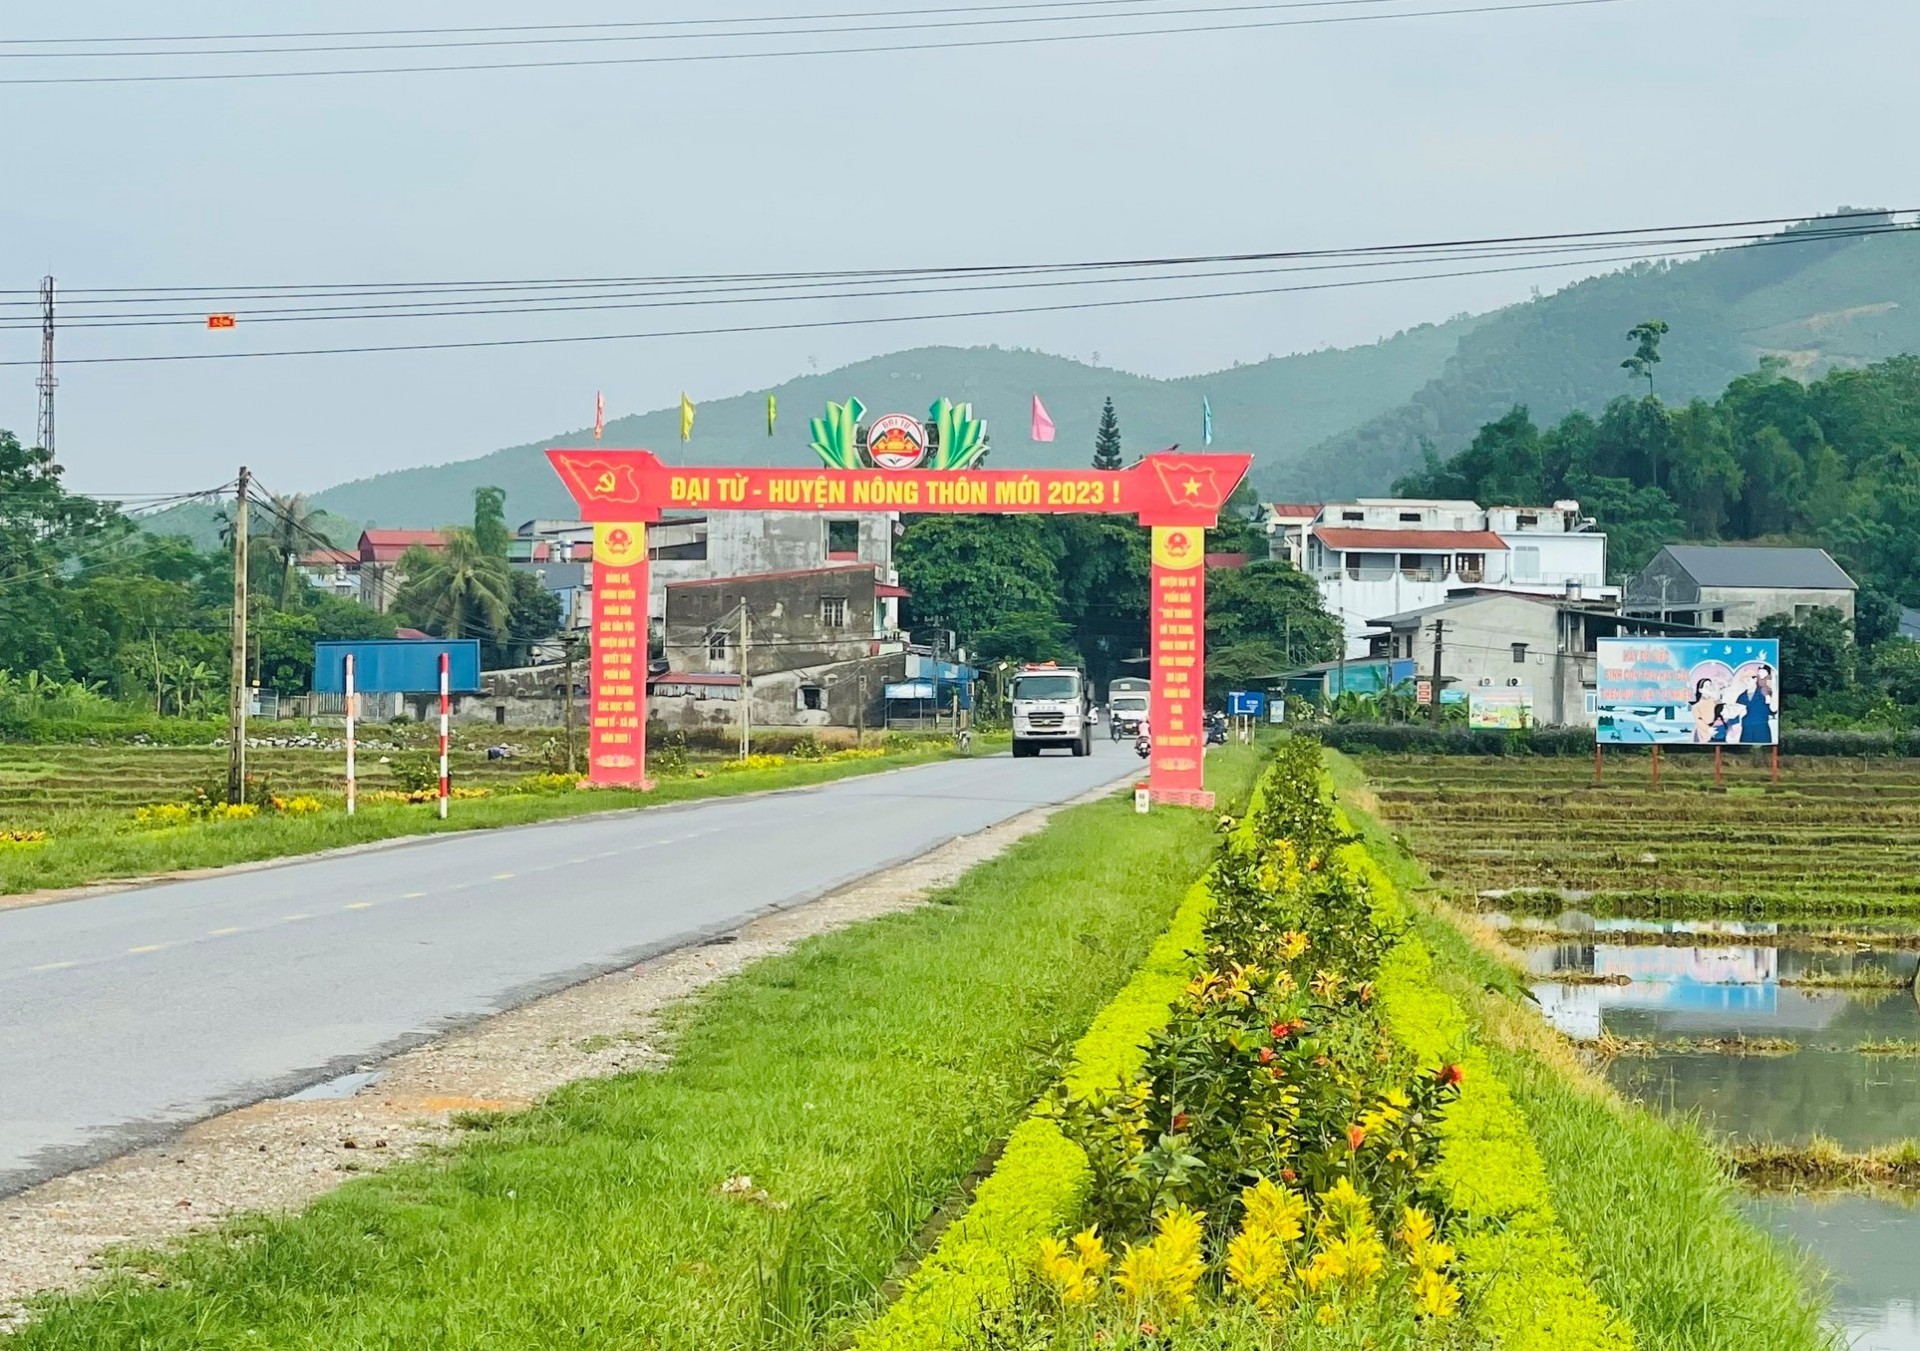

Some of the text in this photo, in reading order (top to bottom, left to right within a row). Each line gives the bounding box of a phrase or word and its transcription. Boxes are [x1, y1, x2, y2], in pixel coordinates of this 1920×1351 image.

[671, 477, 710, 506] ĐẠI
[717, 473, 749, 502] TỪ
[769, 476, 845, 508] HUYỆN
[853, 476, 919, 504] NÔNG
[926, 477, 987, 504] THÔN
[995, 475, 1040, 504] MỚI
[1048, 481, 1104, 504] 2023
[1113, 481, 1120, 504] !
